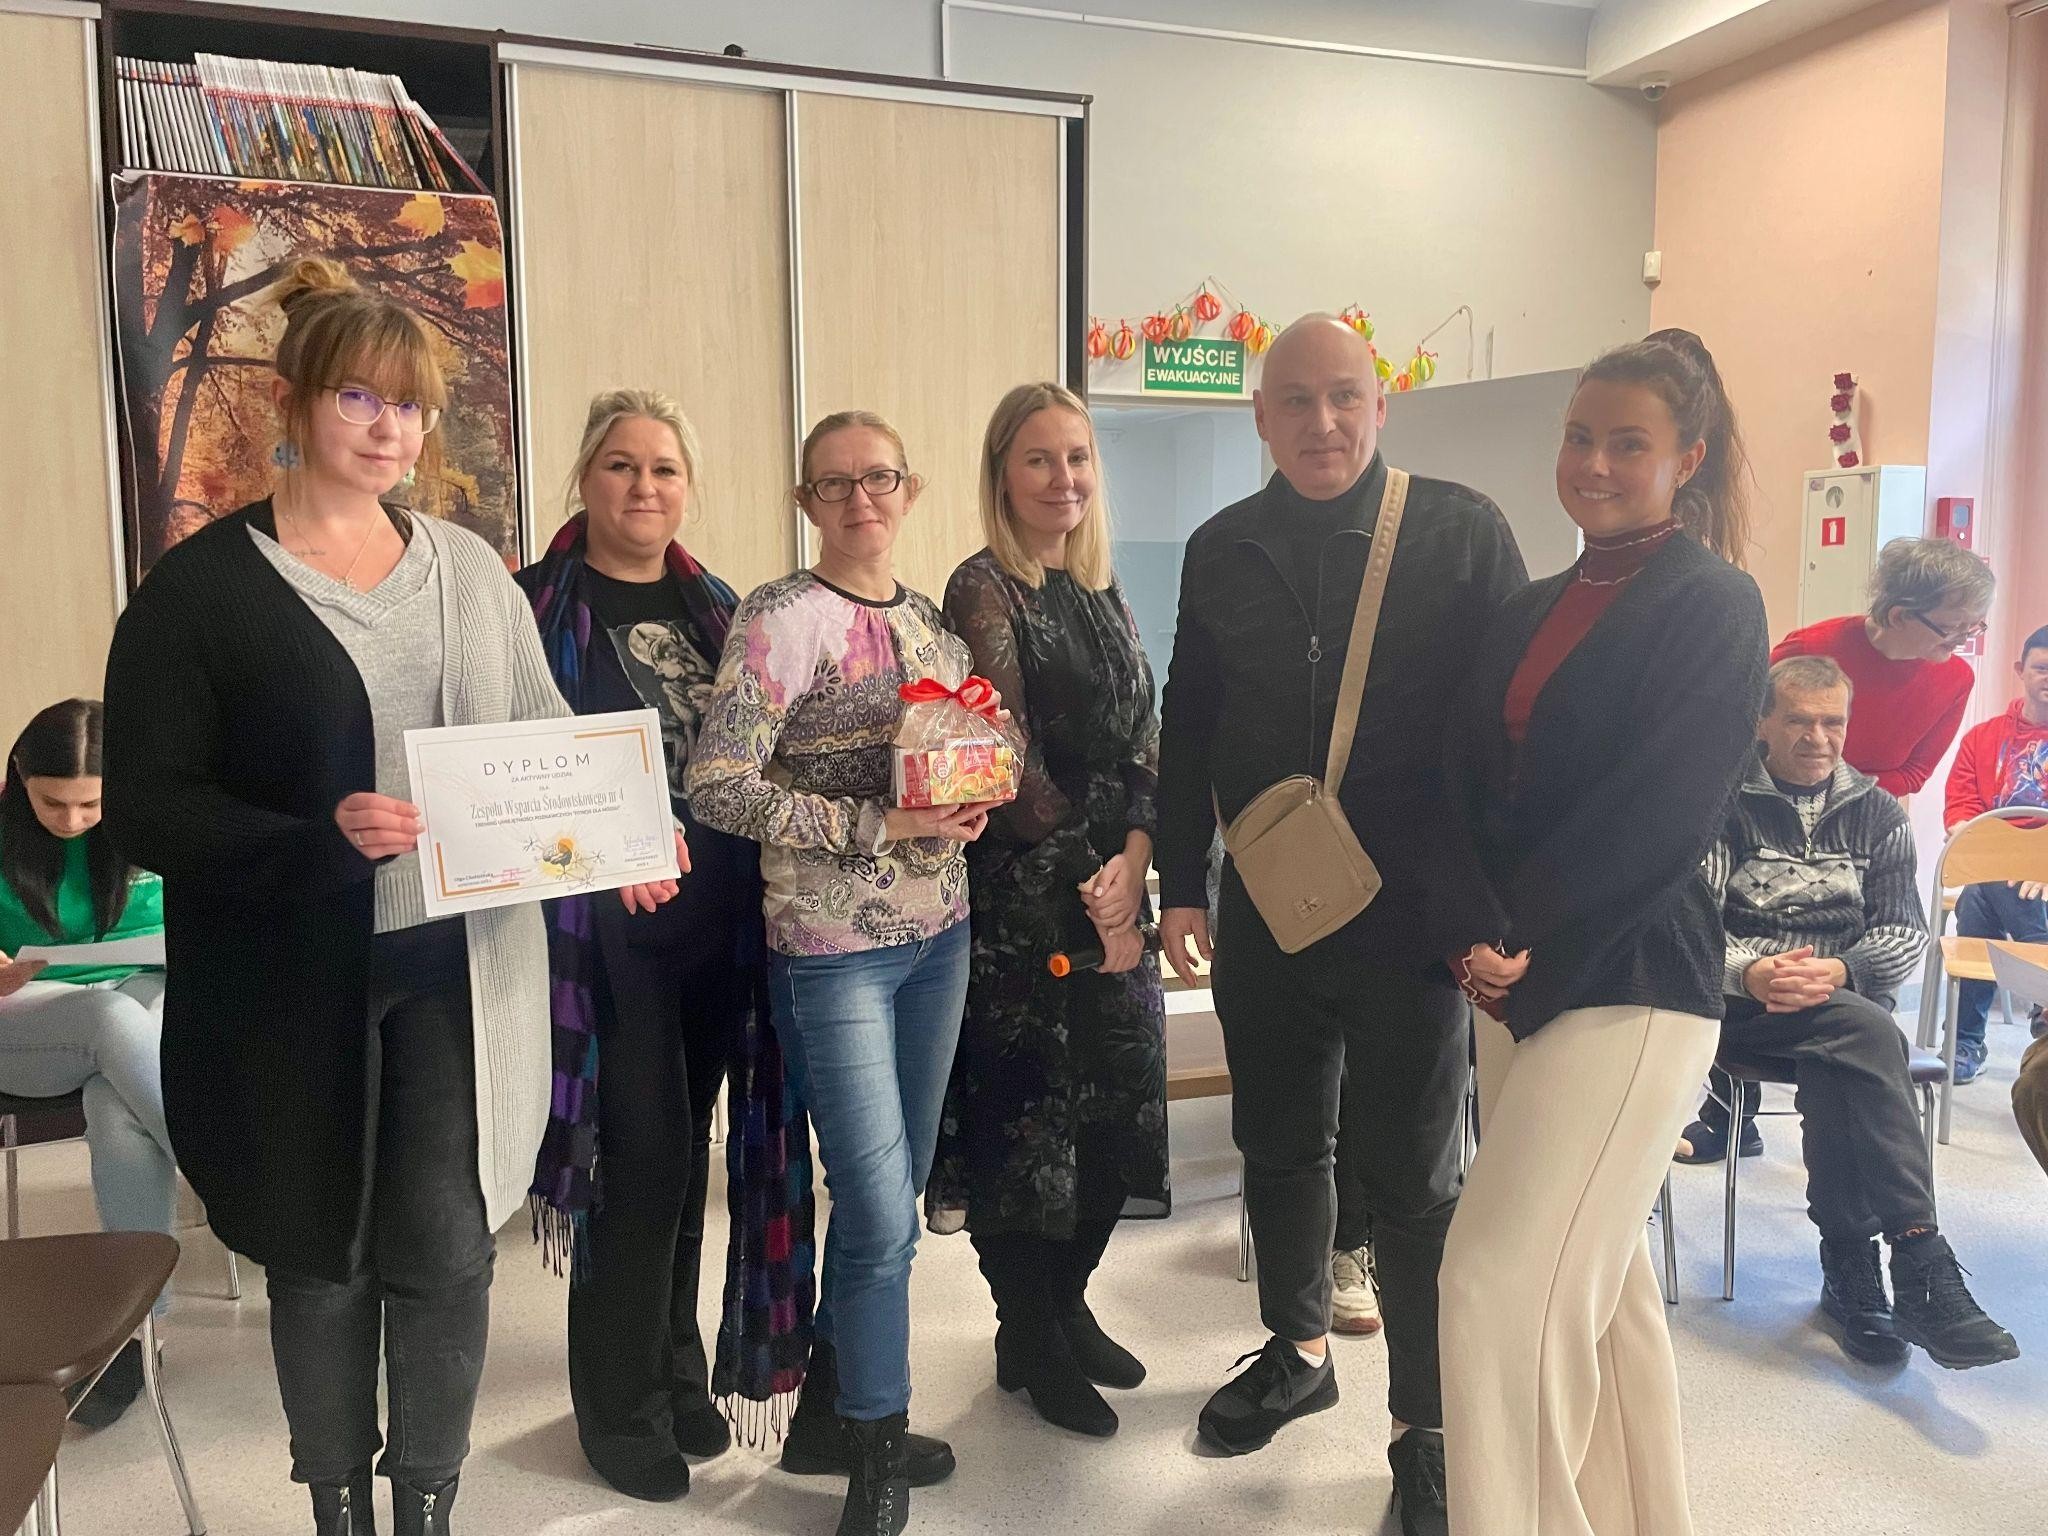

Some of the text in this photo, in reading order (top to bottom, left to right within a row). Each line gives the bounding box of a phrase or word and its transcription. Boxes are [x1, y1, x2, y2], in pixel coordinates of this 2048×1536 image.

[1153, 344, 1237, 367] WYJŚCIE
[1147, 368, 1241, 385] EWAKUACYJNE
[483, 753, 590, 776] DYPLOM
[504, 798, 542, 817] Wsparcia
[543, 792, 607, 811] Środowiskowego
[608, 790, 617, 803] nr
[618, 787, 624, 801] 4
